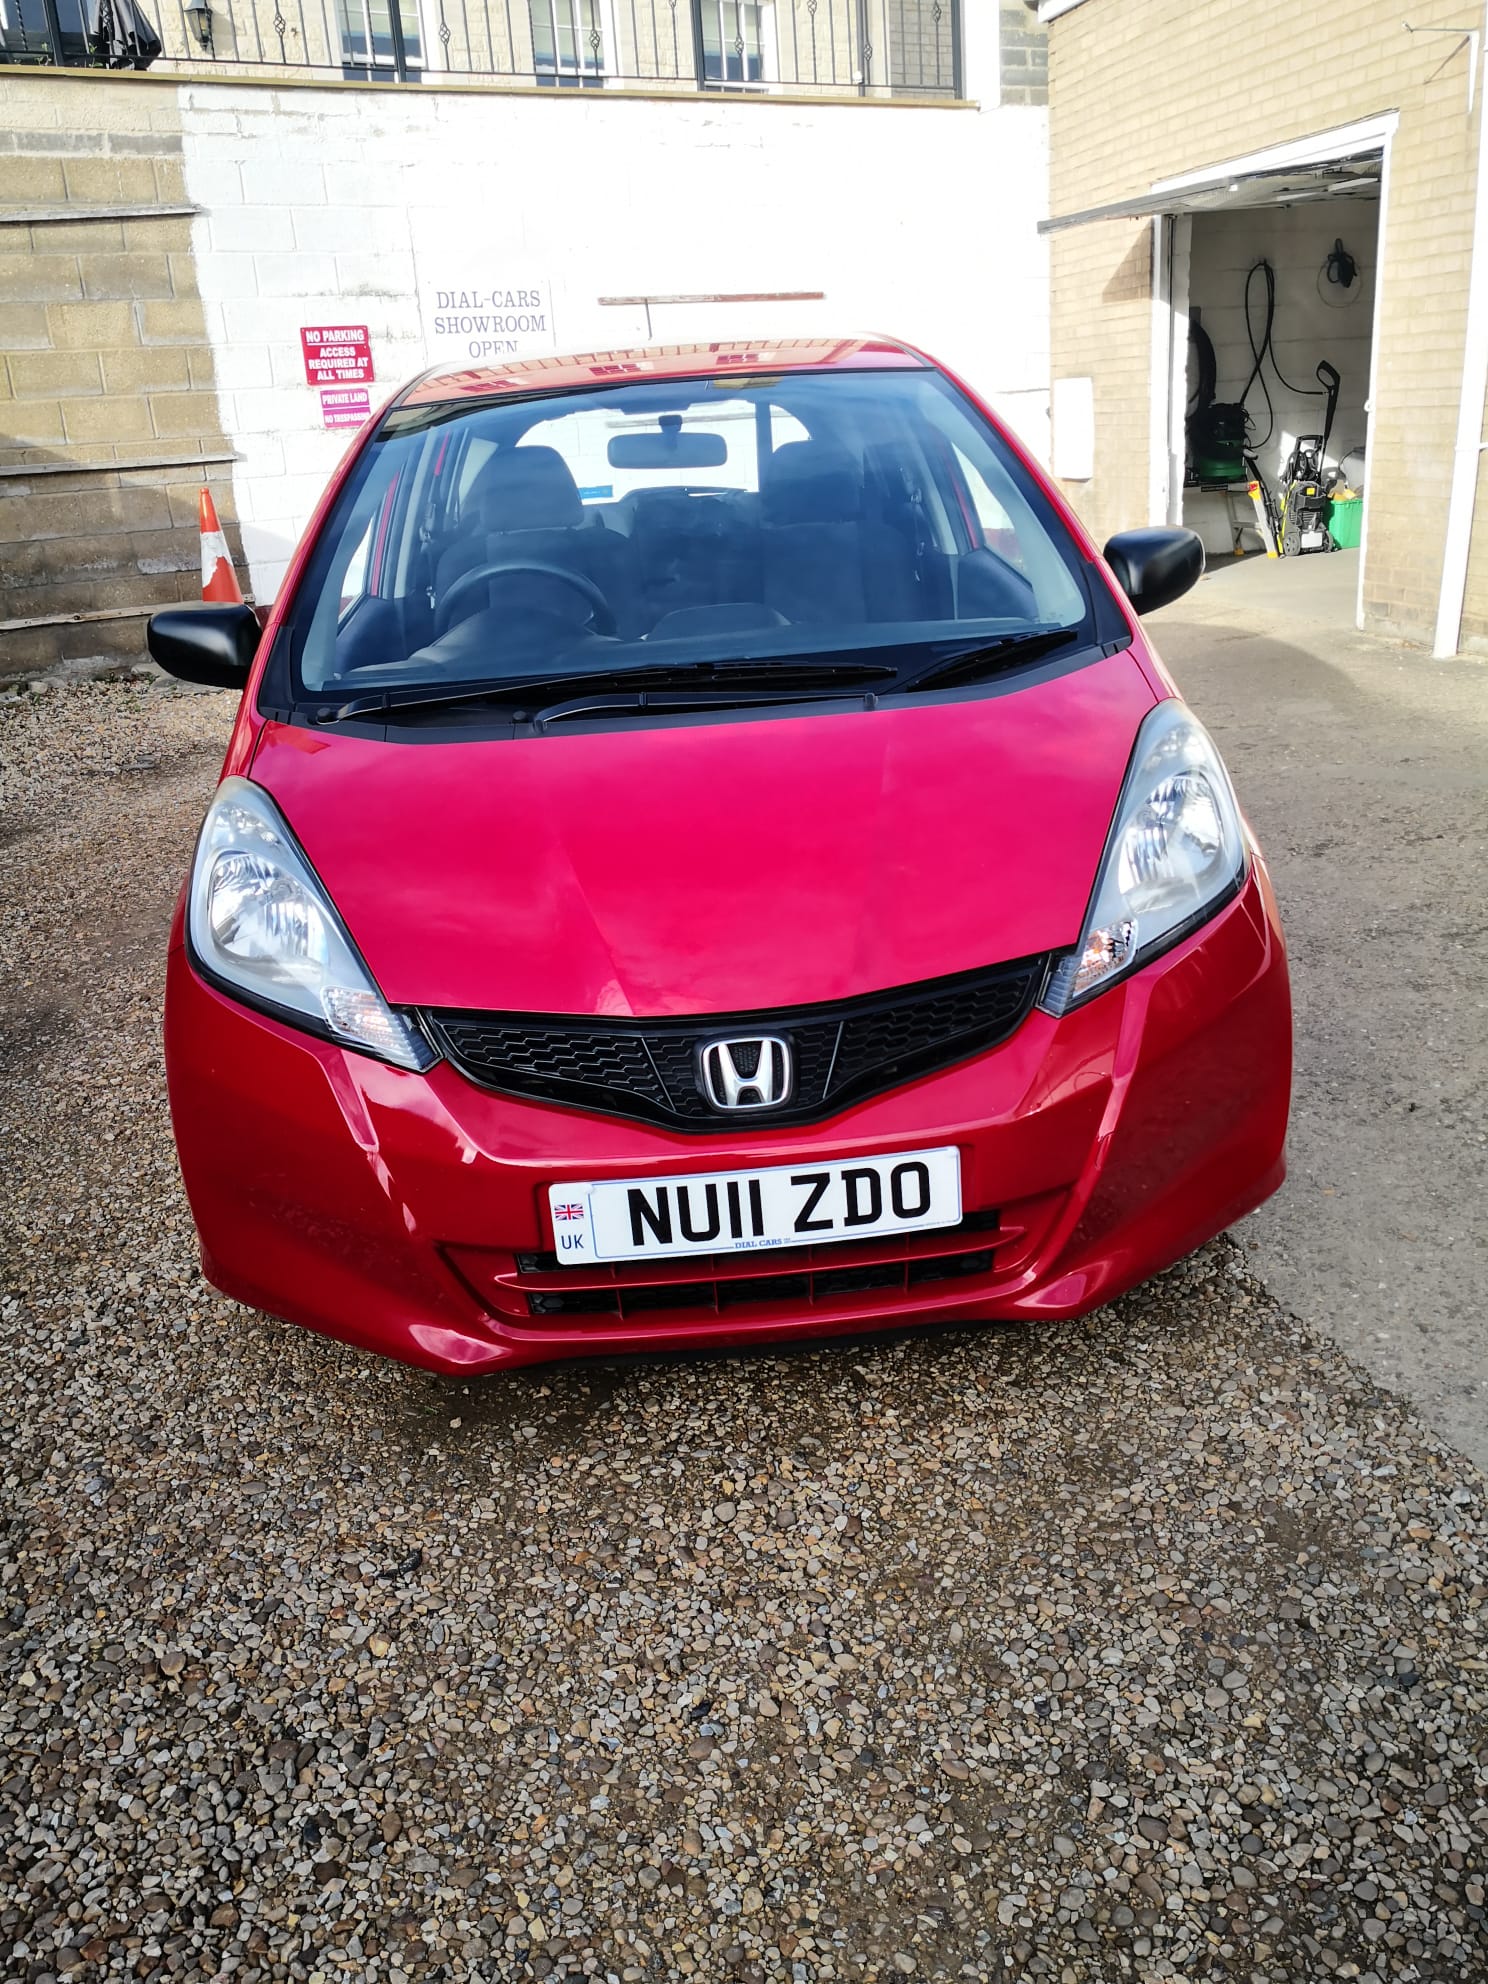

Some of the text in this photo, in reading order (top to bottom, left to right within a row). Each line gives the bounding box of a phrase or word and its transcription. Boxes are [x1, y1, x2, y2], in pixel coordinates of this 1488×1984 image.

[436, 290, 541, 309] DIAL-CARS
[434, 315, 547, 335] SHOWROOM
[305, 329, 365, 343] NO PARKING
[320, 346, 356, 358] ACCESS
[468, 340, 519, 359] OPEN
[308, 357, 369, 370] REQUIRED AT
[317, 368, 365, 381] ALL TIMES
[322, 391, 368, 405] PRIVATE LAND
[324, 415, 334, 423] NO
[627, 1161, 931, 1247] NU11 ZDO
[561, 1234, 585, 1250] UK
[735, 1241, 758, 1249] DIAL
[758, 1238, 783, 1247] CARS
